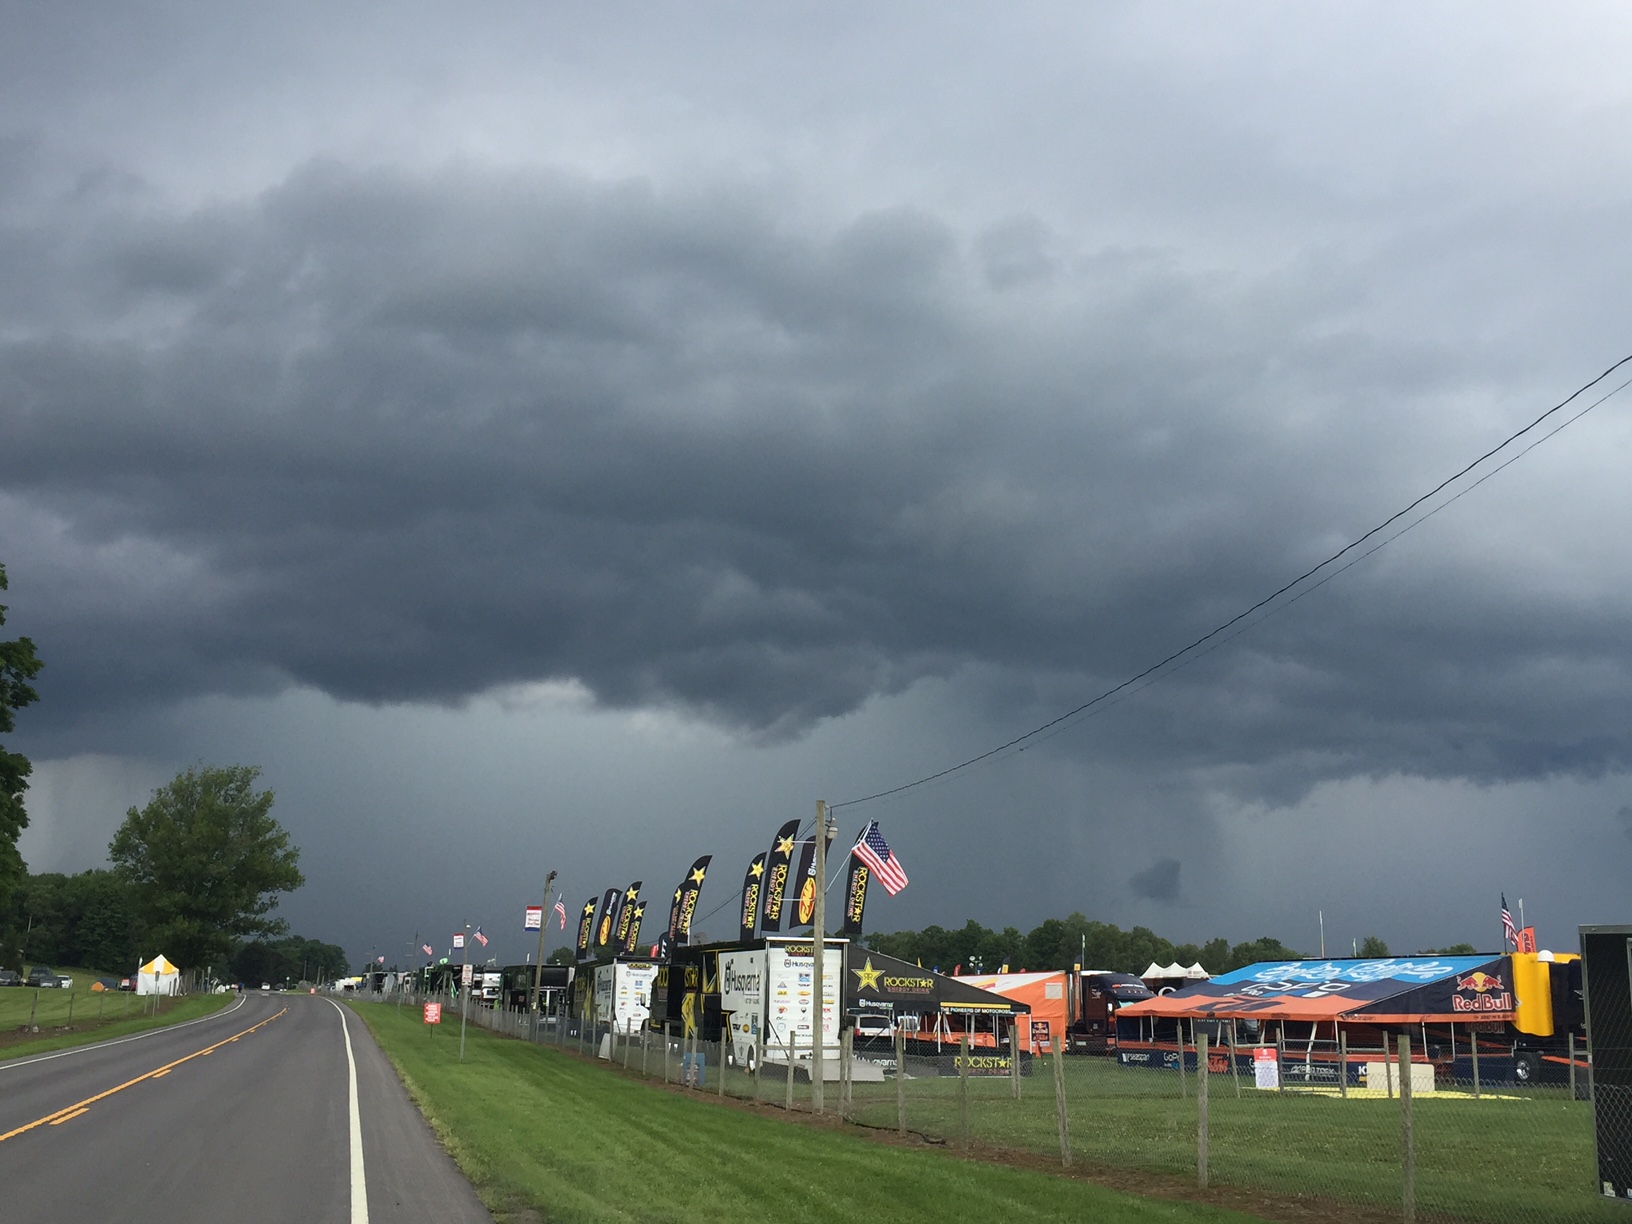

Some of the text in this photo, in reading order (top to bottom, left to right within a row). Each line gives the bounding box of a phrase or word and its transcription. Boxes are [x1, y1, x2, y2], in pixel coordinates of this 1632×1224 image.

[745, 884, 759, 929] ROCKSTAR
[769, 864, 788, 921] ROCKSTAR
[852, 866, 868, 923] ROCKSTAR
[883, 977, 935, 989] ROCKSTAR
[1452, 992, 1512, 1012] Red Bull
[954, 1056, 1013, 1069] RCKSTAR
